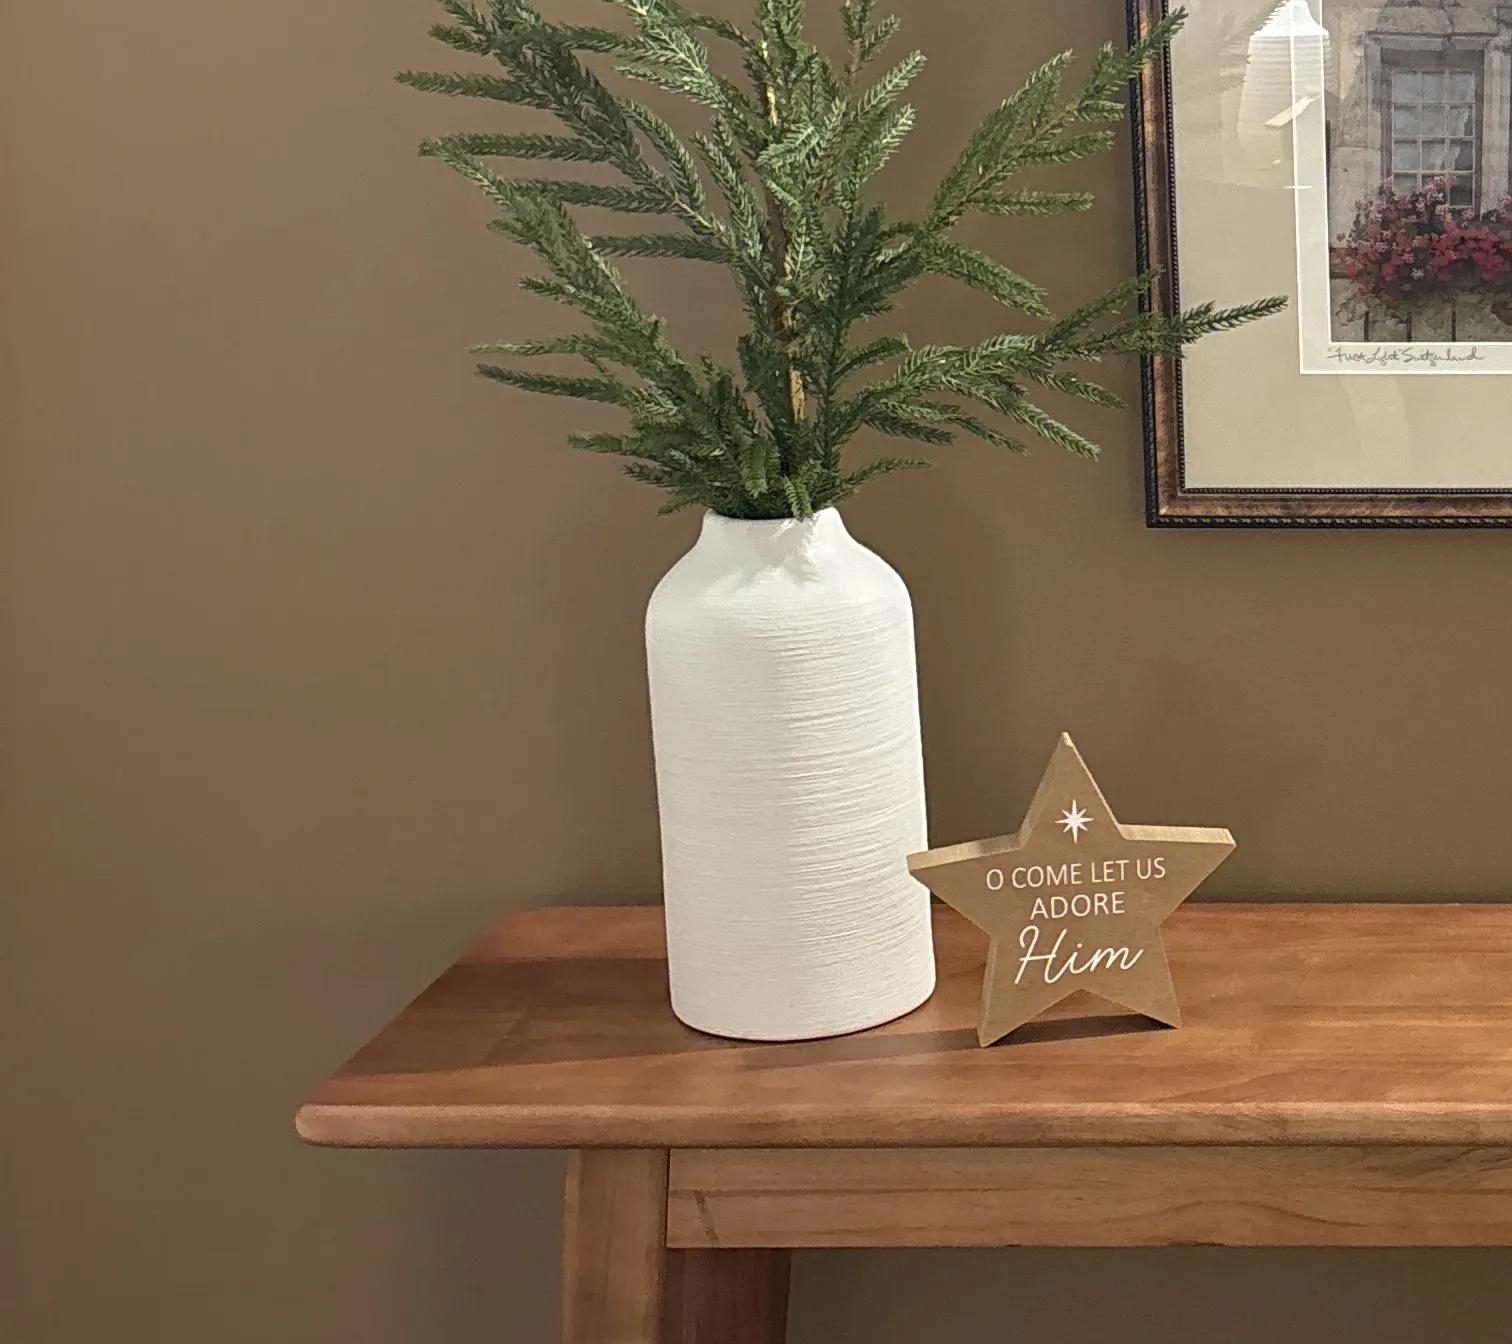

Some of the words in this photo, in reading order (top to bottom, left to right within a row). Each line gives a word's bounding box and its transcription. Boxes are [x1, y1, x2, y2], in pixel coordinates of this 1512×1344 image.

[986, 868, 1004, 891] O
[1011, 862, 1083, 889] COME
[1090, 859, 1130, 883] LET
[1136, 857, 1167, 880] US
[1029, 891, 1126, 921] ADORE
[1013, 924, 1145, 985] Him
